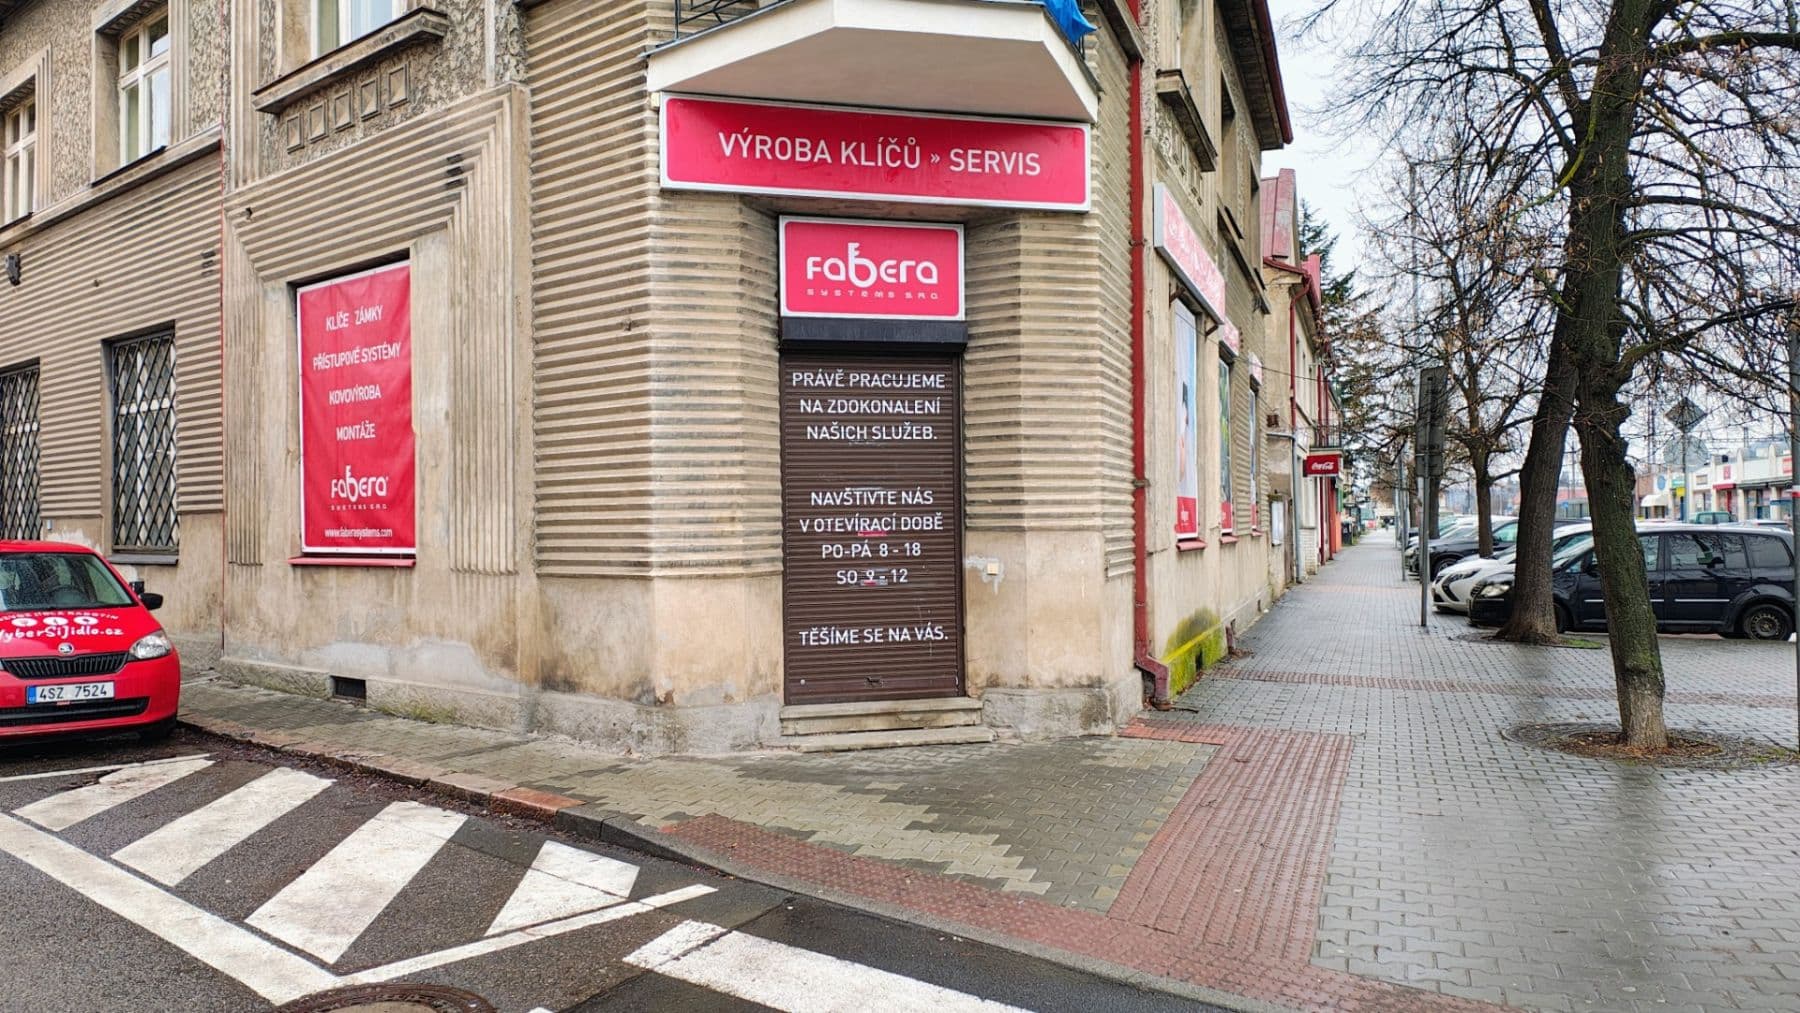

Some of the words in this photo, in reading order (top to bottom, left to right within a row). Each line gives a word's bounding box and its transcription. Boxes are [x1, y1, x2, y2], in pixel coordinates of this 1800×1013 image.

[718, 127, 832, 164] VÝROBA
[841, 135, 921, 169] KLÍČŮ
[949, 148, 1041, 176] SERVIS
[326, 310, 350, 331] KLÍČE
[354, 304, 383, 325] ZÁMKY
[313, 345, 360, 371] PŘÍSTUPOVÉ
[361, 341, 401, 363] SYSTÉMY
[792, 368, 845, 387] PRÁVĚ
[849, 372, 946, 389] PRACUJEME
[328, 383, 381, 405] KOVOVÝROBA
[800, 399, 824, 414] NA
[827, 397, 941, 414] ZDOKONALENÍ
[336, 420, 376, 440] MONTÁŽE
[806, 421, 867, 440] NAŠICH
[872, 421, 938, 440] SLUŽEB.
[811, 488, 897, 506] NAVŠTIVTE
[901, 486, 934, 505] NÁS
[799, 519, 810, 533] V
[814, 513, 897, 532] OTEVÍRACÍ
[901, 512, 944, 531] DOBĚ
[822, 539, 872, 559] PO-PÁ
[879, 543, 889, 558] 8
[904, 542, 922, 557] 18
[836, 570, 858, 585] SO
[865, 569, 875, 583] 9
[891, 569, 908, 583] 12
[799, 626, 859, 646] TĚŠÍME
[863, 628, 884, 644] SE
[888, 626, 911, 642] NA
[914, 622, 949, 641] VÁS.
[40, 686, 65, 700] 4SZ
[75, 684, 107, 698] 7524
